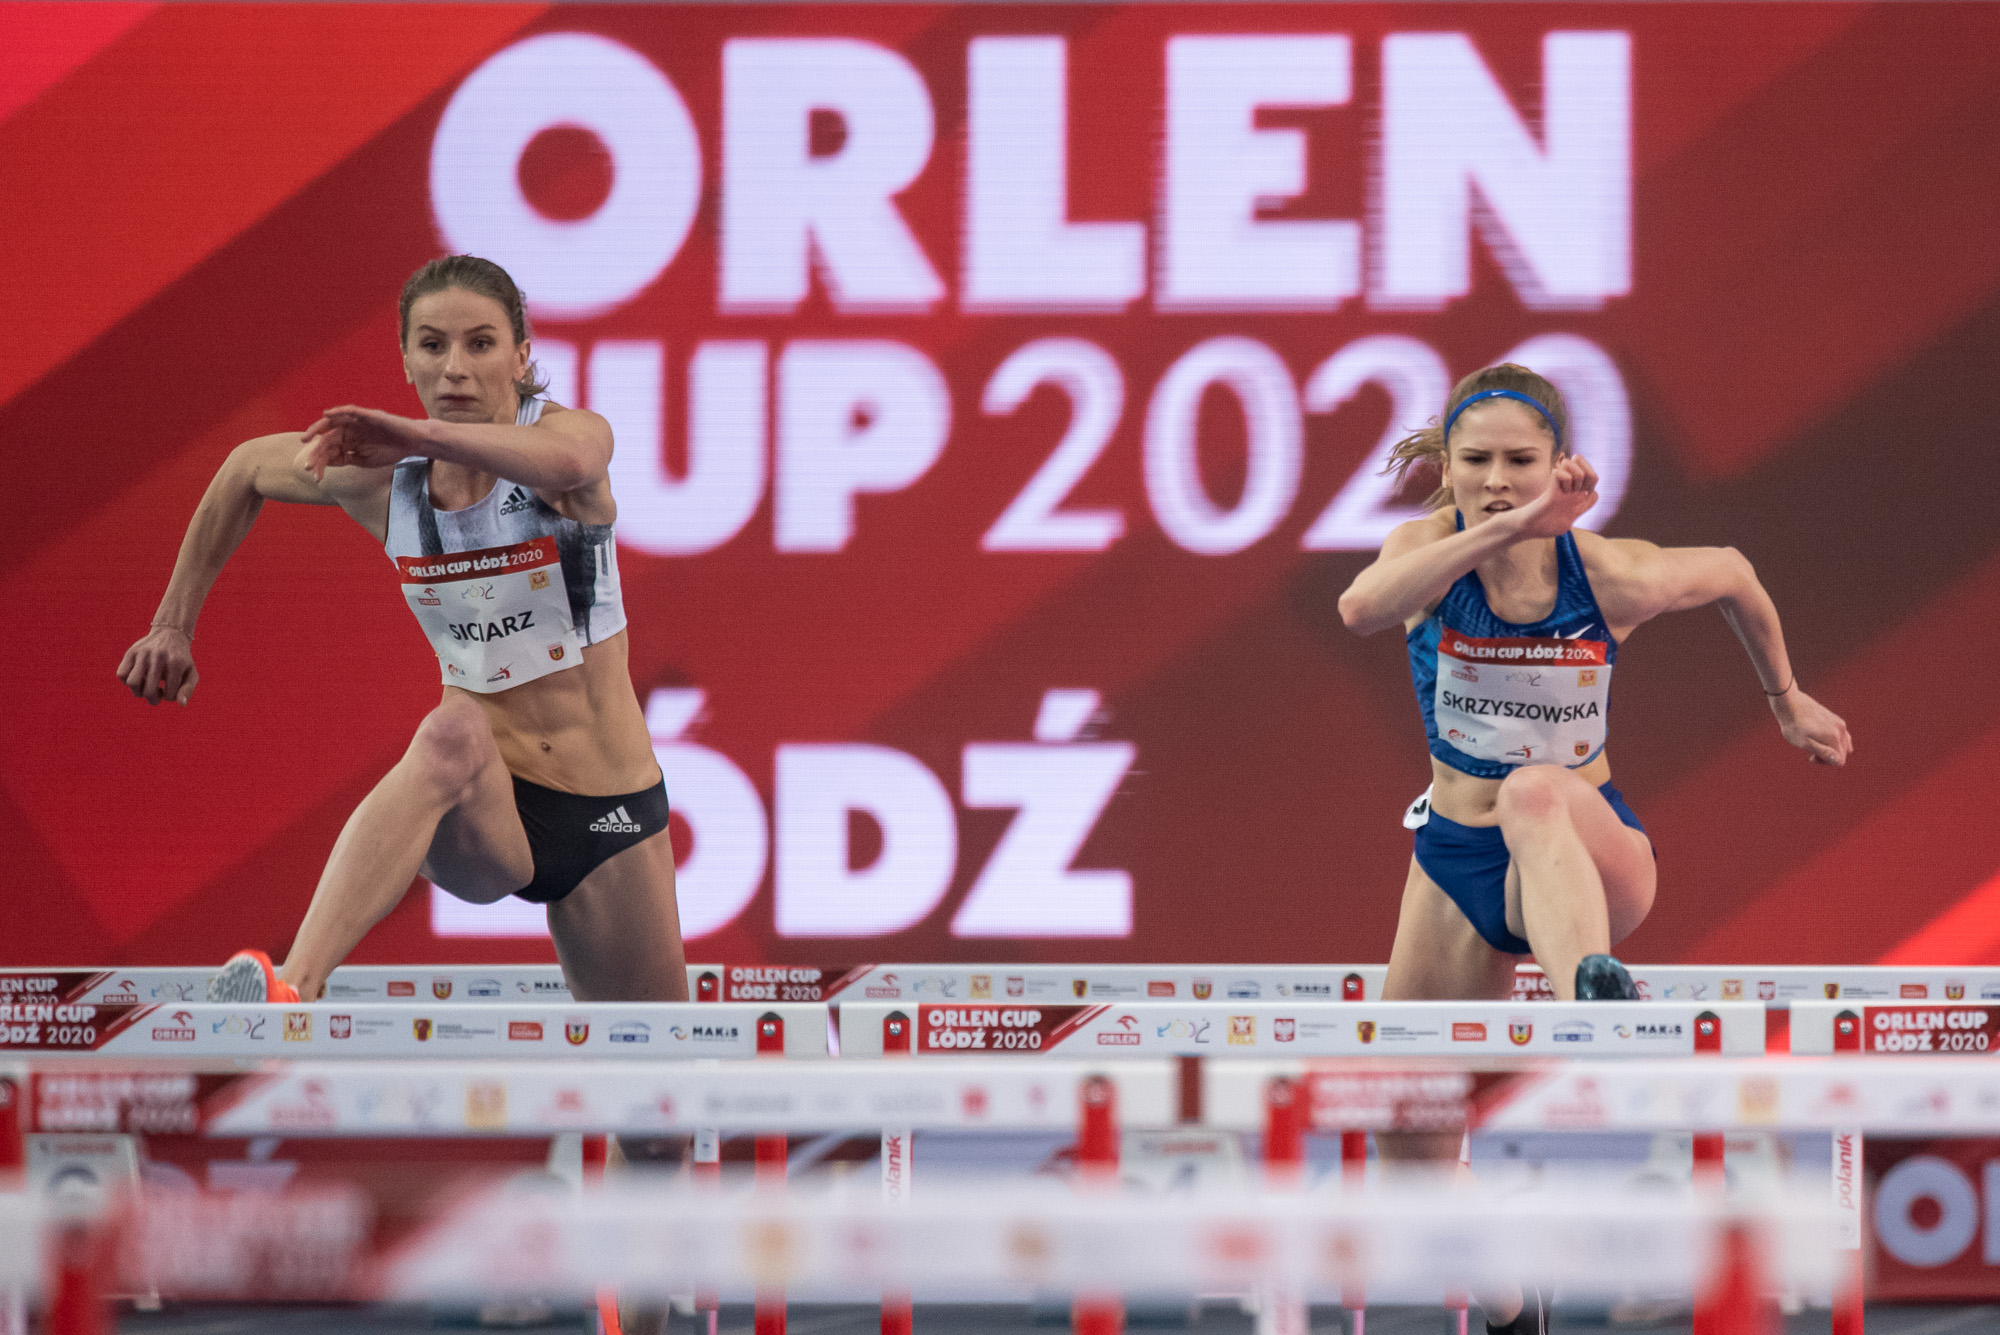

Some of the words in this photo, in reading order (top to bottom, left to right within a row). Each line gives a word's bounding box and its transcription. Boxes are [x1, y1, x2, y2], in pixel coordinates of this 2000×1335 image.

[430, 32, 1634, 318] ORLEN
[528, 338, 953, 556] UP
[980, 332, 1634, 556] 2020
[408, 566, 446, 578] ORLEN
[446, 561, 472, 574] CUP
[473, 553, 510, 572] ŁÓDŹ
[510, 548, 543, 566] 2020
[449, 610, 535, 643] SICIARZ
[1453, 640, 1496, 658] ORLEN
[1497, 647, 1523, 659] CUP
[1525, 643, 1564, 659] ŁÓDŹ
[1442, 690, 1599, 724] SKRZYSZOWSKA
[430, 687, 1135, 942] ÓDŹ
[589, 822, 641, 833] adidas
[25, 978, 58, 993] CUP
[732, 968, 787, 983] ORLEN
[789, 969, 822, 984] CUP
[781, 985, 822, 1001] 2020
[0, 1005, 53, 1023] RLEN
[55, 1005, 96, 1023] CUP
[928, 1009, 997, 1028] ORLEN
[1000, 1010, 1042, 1028] CUP
[1873, 1013, 1945, 1030] ORLEN
[1946, 1011, 1989, 1029] CUP
[0, 1022, 40, 1044] ÓDŹ
[46, 1026, 96, 1044] 2020
[152, 1029, 195, 1041] ORLEN
[928, 1028, 986, 1048] ŁÓDŹ
[992, 1031, 1042, 1049] 2020
[1098, 1033, 1140, 1045] ORLEN
[1874, 1030, 1933, 1052] ŁÓDŹ
[1938, 1032, 1989, 1051] 2020
[885, 1132, 902, 1199] olanik
[1837, 1133, 1855, 1211] polanik
